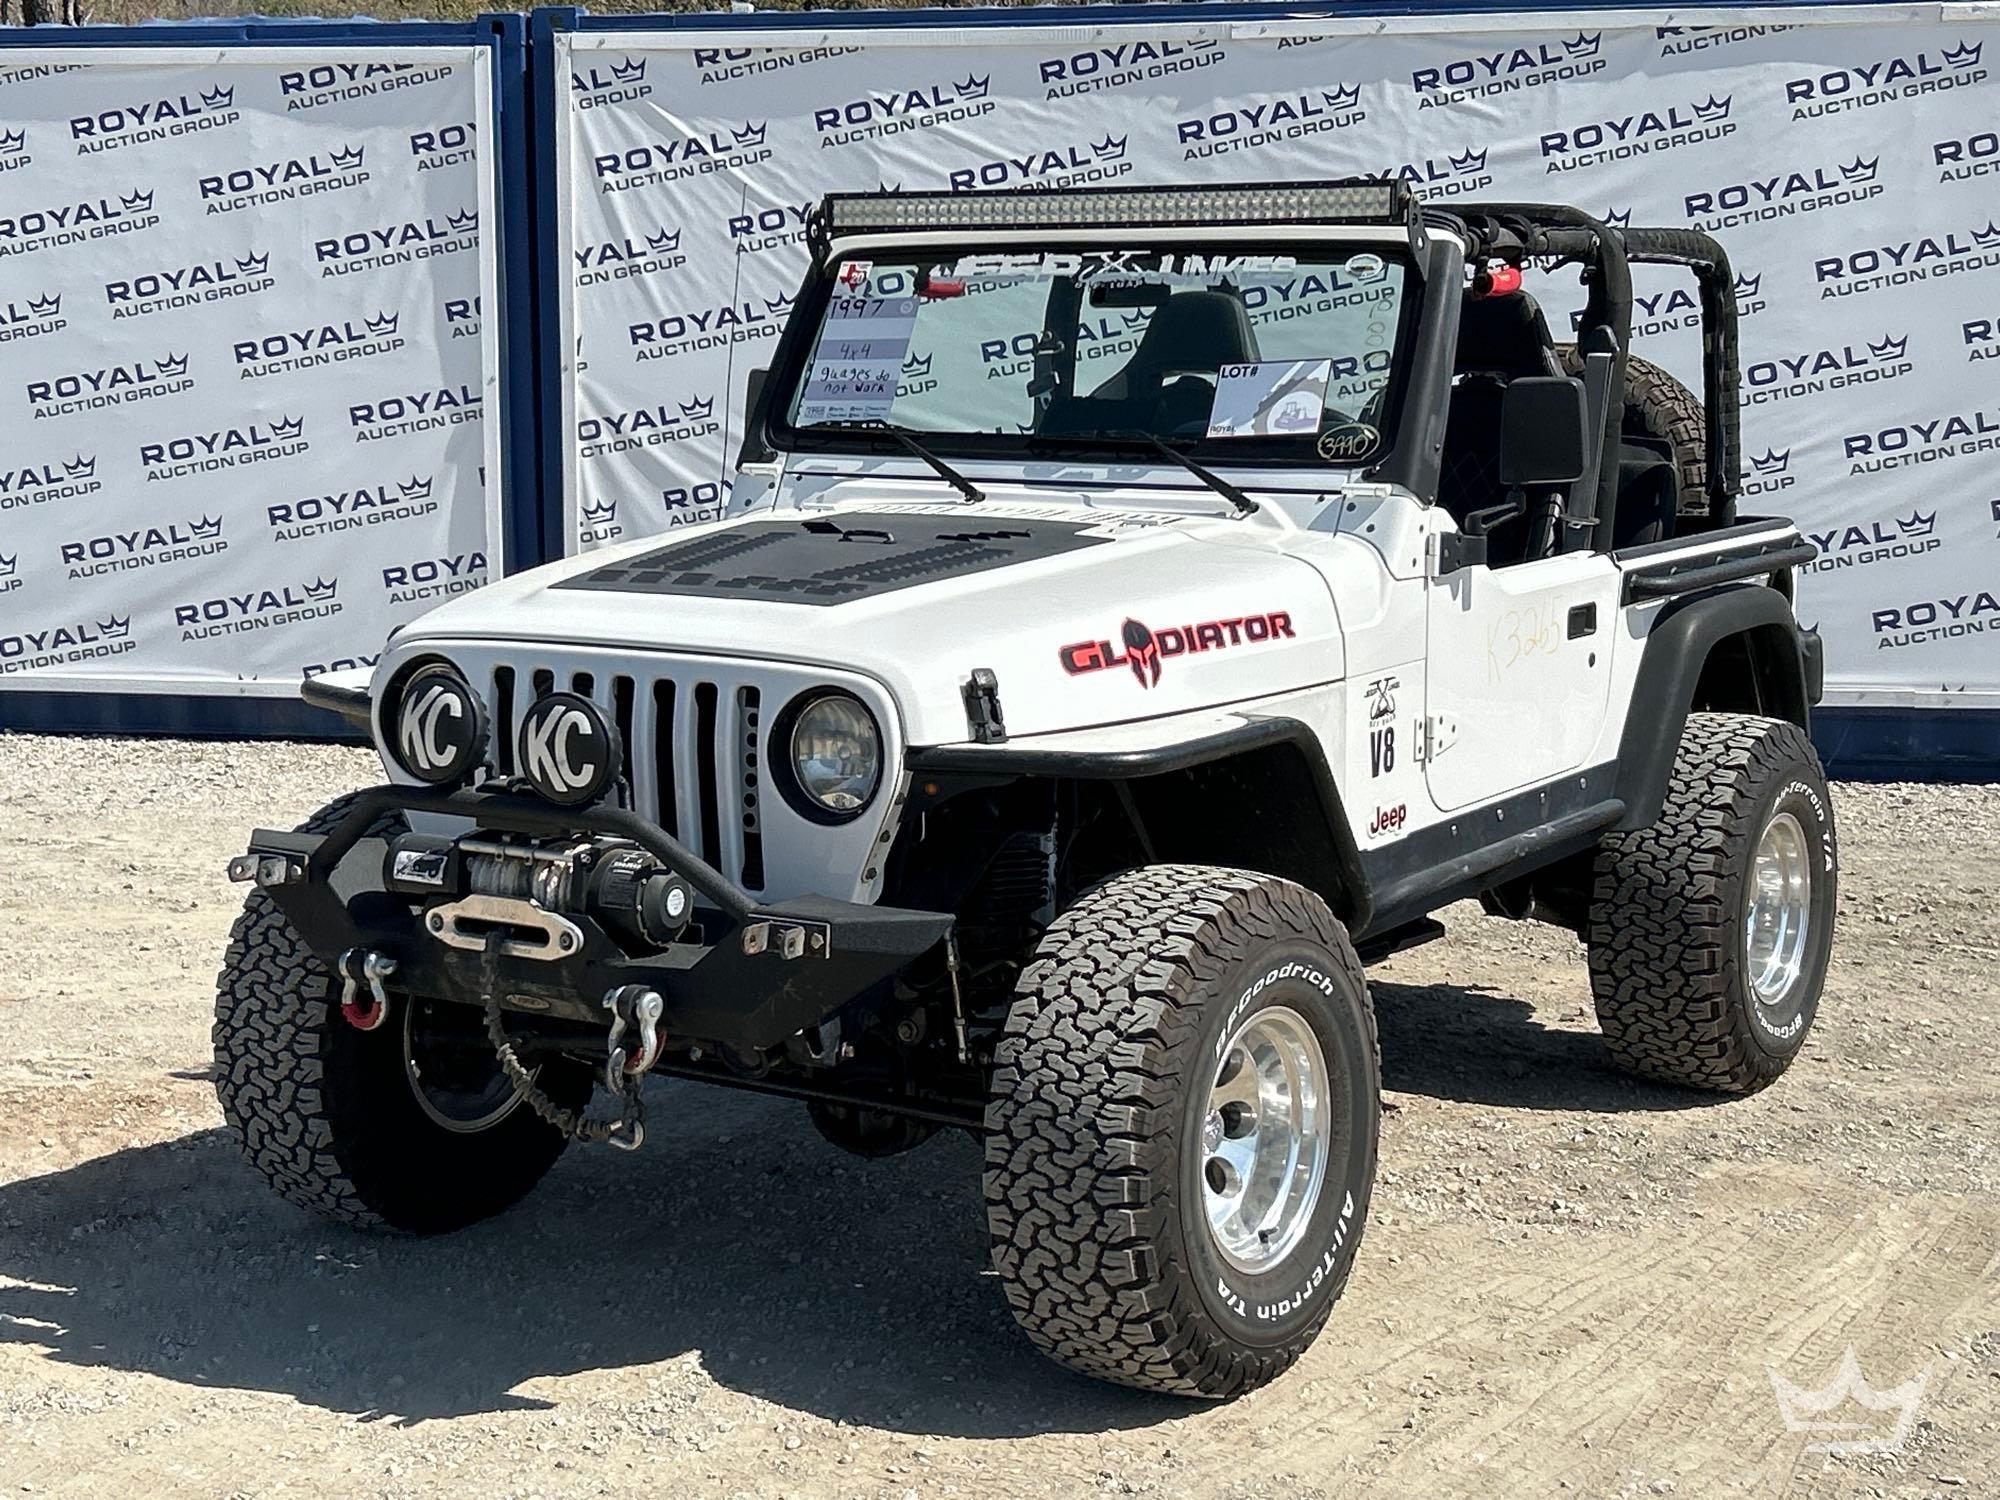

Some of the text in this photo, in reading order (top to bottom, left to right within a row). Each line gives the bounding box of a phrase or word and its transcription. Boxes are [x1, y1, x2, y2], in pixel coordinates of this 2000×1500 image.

[1660, 24, 1767, 58] AUCTION
[701, 54, 794, 85] AUCTION
[1038, 40, 1185, 85] ROYAL
[1045, 50, 1226, 102] AUCTION GROUP
[1411, 43, 1564, 94] ROYAL
[1785, 53, 1943, 105] ROYAL
[287, 66, 453, 113] AUCTION GROUP
[578, 84, 653, 110] GROUP
[1418, 58, 1607, 111] AUCTION GROUP
[1791, 69, 1988, 122] AUCTION GROUP
[69, 95, 202, 140] ROYAL
[813, 84, 955, 133] ROYAL
[820, 101, 996, 150] AUCTION GROUP
[1176, 95, 1324, 145] ROYAL
[77, 111, 240, 156] AUCTION GROUP
[1183, 111, 1367, 162] AUCTION GROUP
[1540, 106, 1693, 158] ROYAL
[1545, 122, 1737, 175] AUCTION GROUP
[594, 132, 733, 178] ROYAL
[601, 148, 773, 195] AUCTION GROUP
[950, 147, 1091, 191] ROYAL
[1056, 162, 1132, 189] GROUP
[198, 155, 332, 200] ROYAL
[206, 171, 370, 216] AUCTION GROUP
[1684, 168, 1840, 218] ROYAL
[1693, 184, 1884, 232] AUCTION GROUP
[0, 215, 160, 258] AUCTION GROUP
[314, 218, 449, 263] ROYAL
[321, 249, 412, 279] AUCTION
[613, 255, 687, 280] GROUP
[1814, 233, 1972, 283] ROYAL
[1820, 252, 2000, 301] AUCTION GROU
[104, 261, 238, 304] ROYAL
[112, 277, 275, 320] AUCTION GROUP
[1241, 270, 1353, 308] OYAL
[1317, 287, 1395, 312] GROUP
[629, 303, 765, 345] ROYAL
[831, 299, 885, 319] 1997
[0, 319, 68, 343] GROUP
[233, 321, 367, 365] ROYAL
[635, 333, 729, 363] AUCTION
[840, 343, 871, 361] 4x4
[240, 338, 405, 380] AUCTION GROUP
[820, 367, 872, 382] guages
[1221, 365, 1259, 379] LOT#
[1747, 346, 1869, 387] OYAL
[1829, 362, 1913, 390] GROUP
[26, 362, 157, 405] ROYAL
[34, 378, 195, 420] AUCTION GROUP
[350, 385, 482, 426] ROYAL
[577, 405, 681, 442] OYAL
[139, 425, 272, 467] ROYAL
[355, 415, 446, 443] AUCTION
[580, 422, 720, 459] CTION GROUP
[1843, 411, 2000, 459] ROYAL
[146, 441, 310, 482] AUCTION GROUP
[1849, 444, 1956, 477] AUCTION
[32, 480, 102, 504] GROUP
[267, 485, 400, 527] ROYAL
[274, 501, 438, 543] AUCTION GROUP
[60, 524, 191, 565] ROYAL
[68, 540, 229, 580] AUCTION GROUP
[1857, 538, 1941, 564] GROUP
[383, 552, 487, 588] ROYA
[390, 578, 479, 604] AUCTION
[174, 586, 306, 627] ROYAL
[181, 602, 343, 642] AUCTION GROUP
[1871, 591, 2000, 633] ROYA
[0, 624, 100, 658] OYAL
[67, 640, 137, 663] GROUP
[1878, 620, 1985, 650] AUCTION
[402, 685, 462, 770] KC
[527, 705, 595, 792] KC
[1370, 726, 1395, 778] V8
[1370, 803, 1407, 834] Jeep
